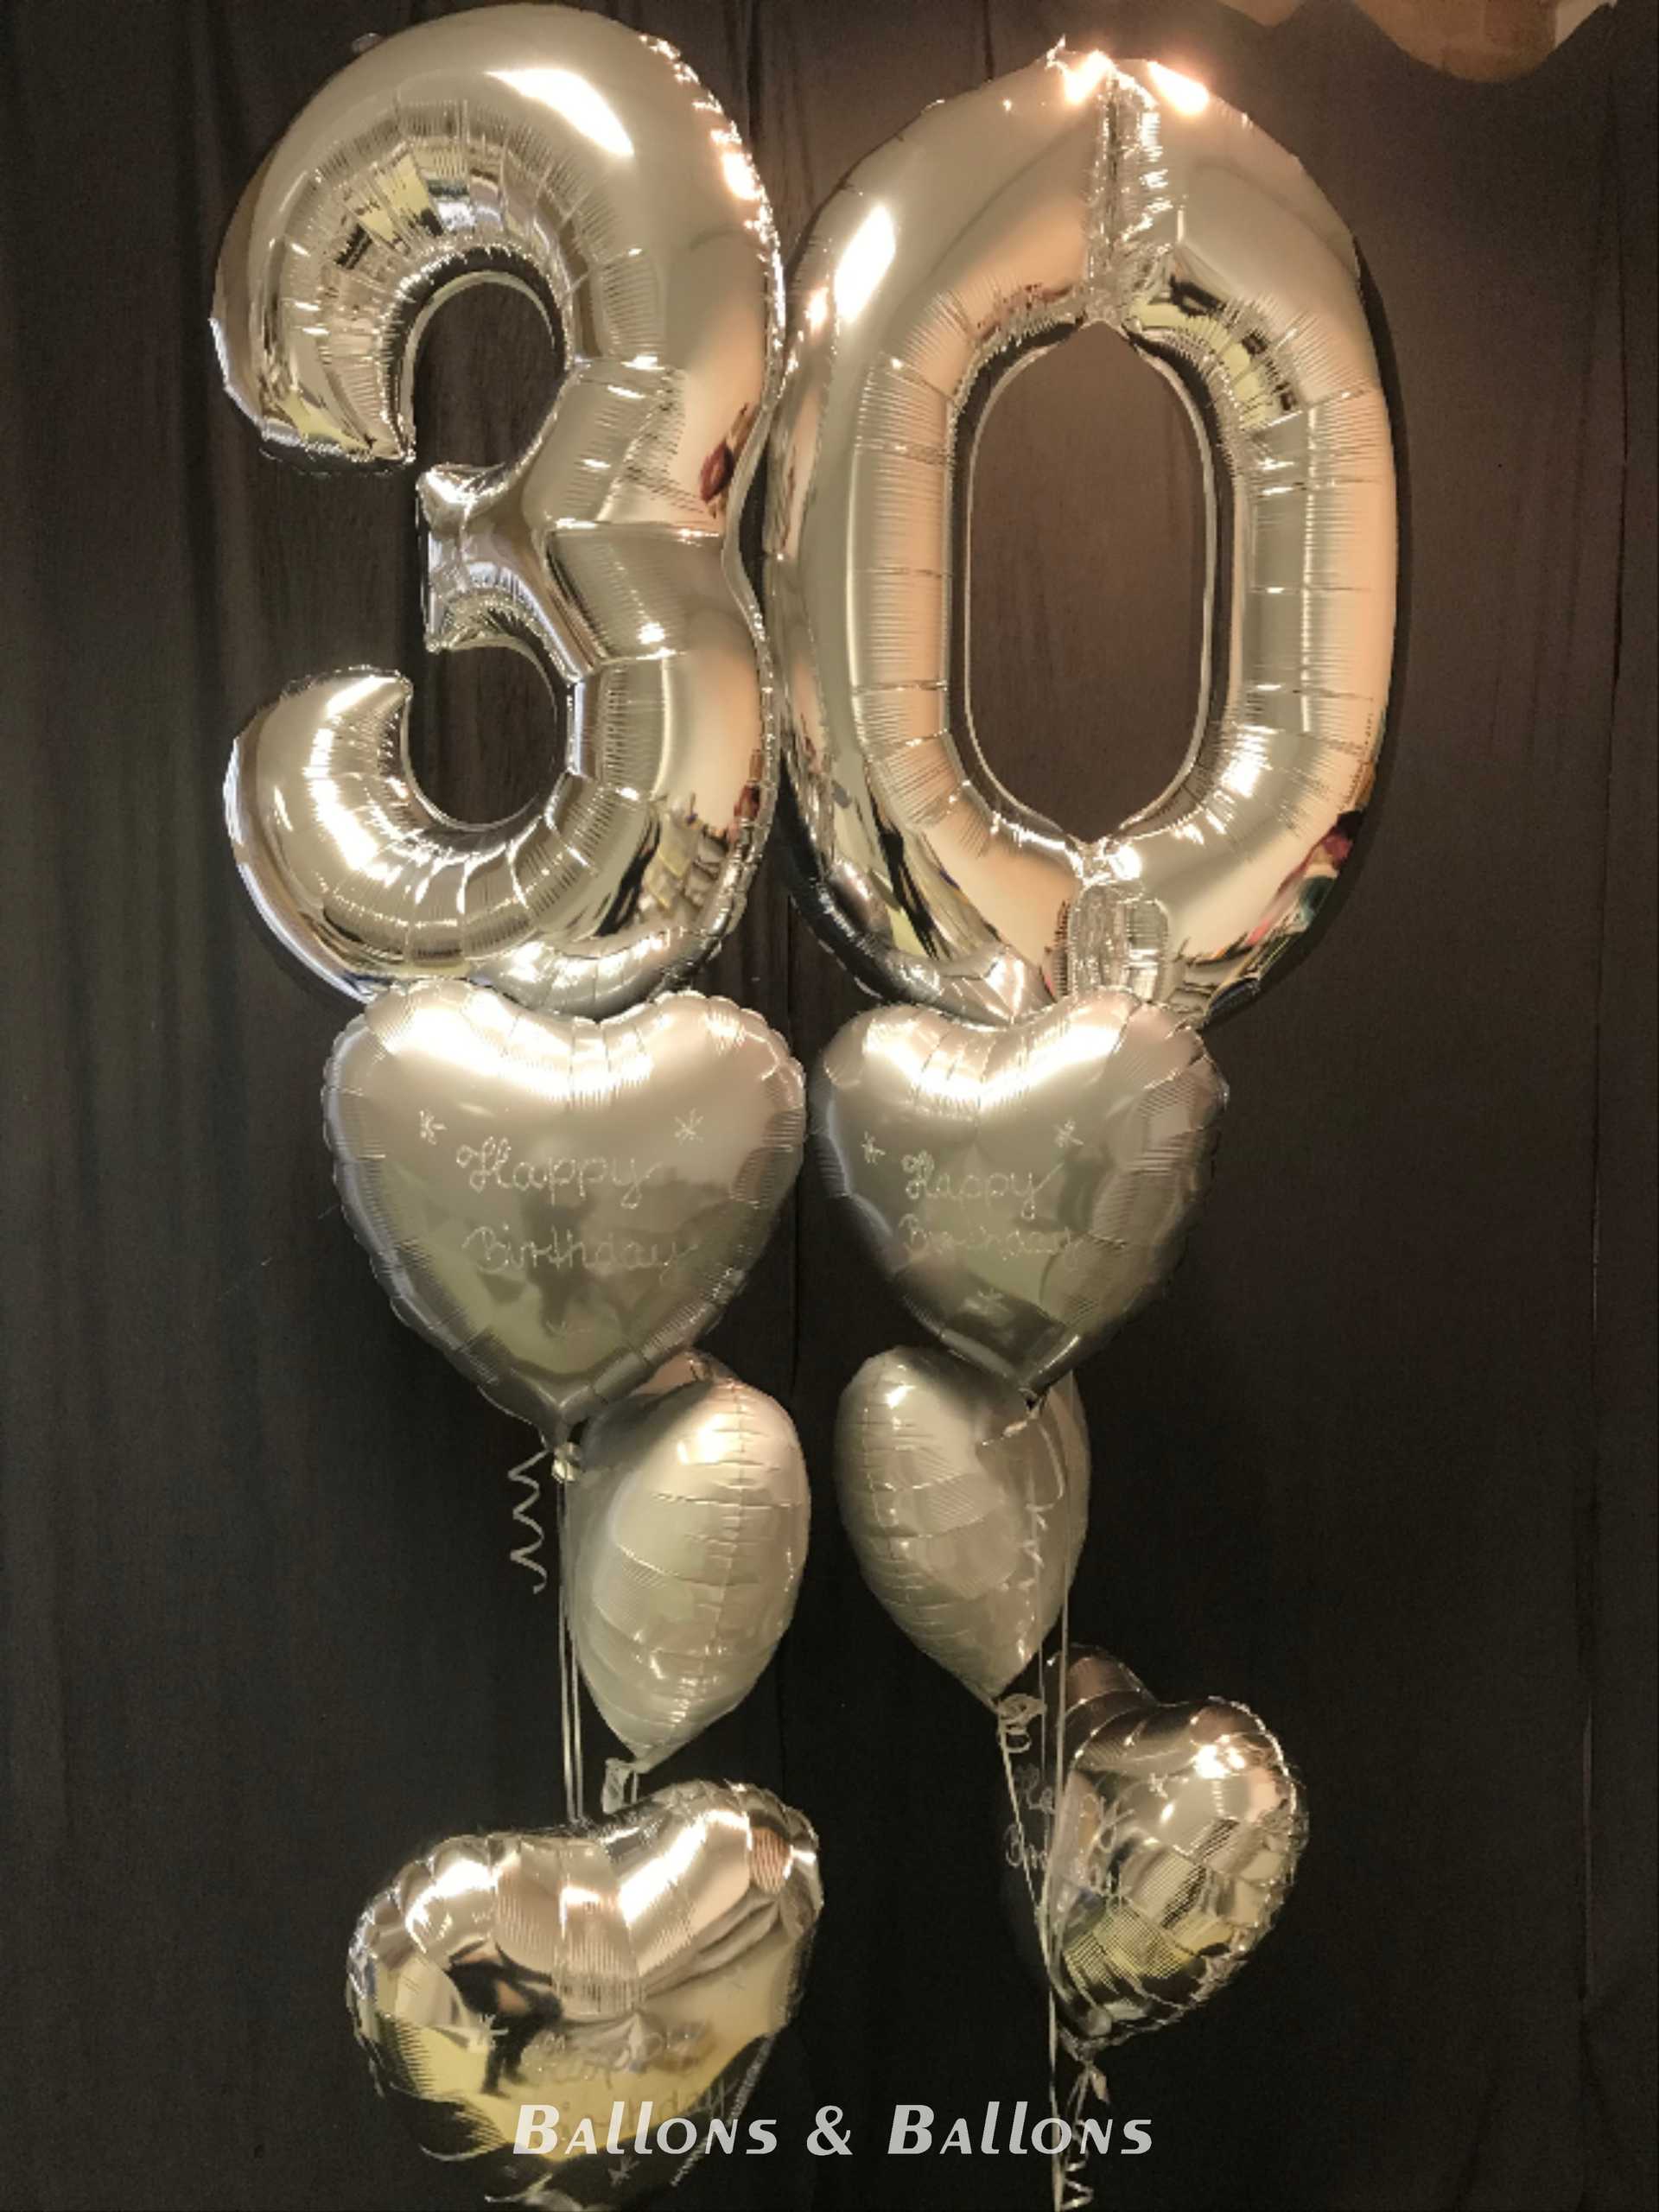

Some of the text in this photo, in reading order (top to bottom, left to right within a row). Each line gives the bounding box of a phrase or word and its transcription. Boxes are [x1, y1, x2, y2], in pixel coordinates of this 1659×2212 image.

[456, 1136, 663, 1210] Happy
[901, 1149, 1064, 1219] Happy
[461, 1224, 698, 1286] Birthday
